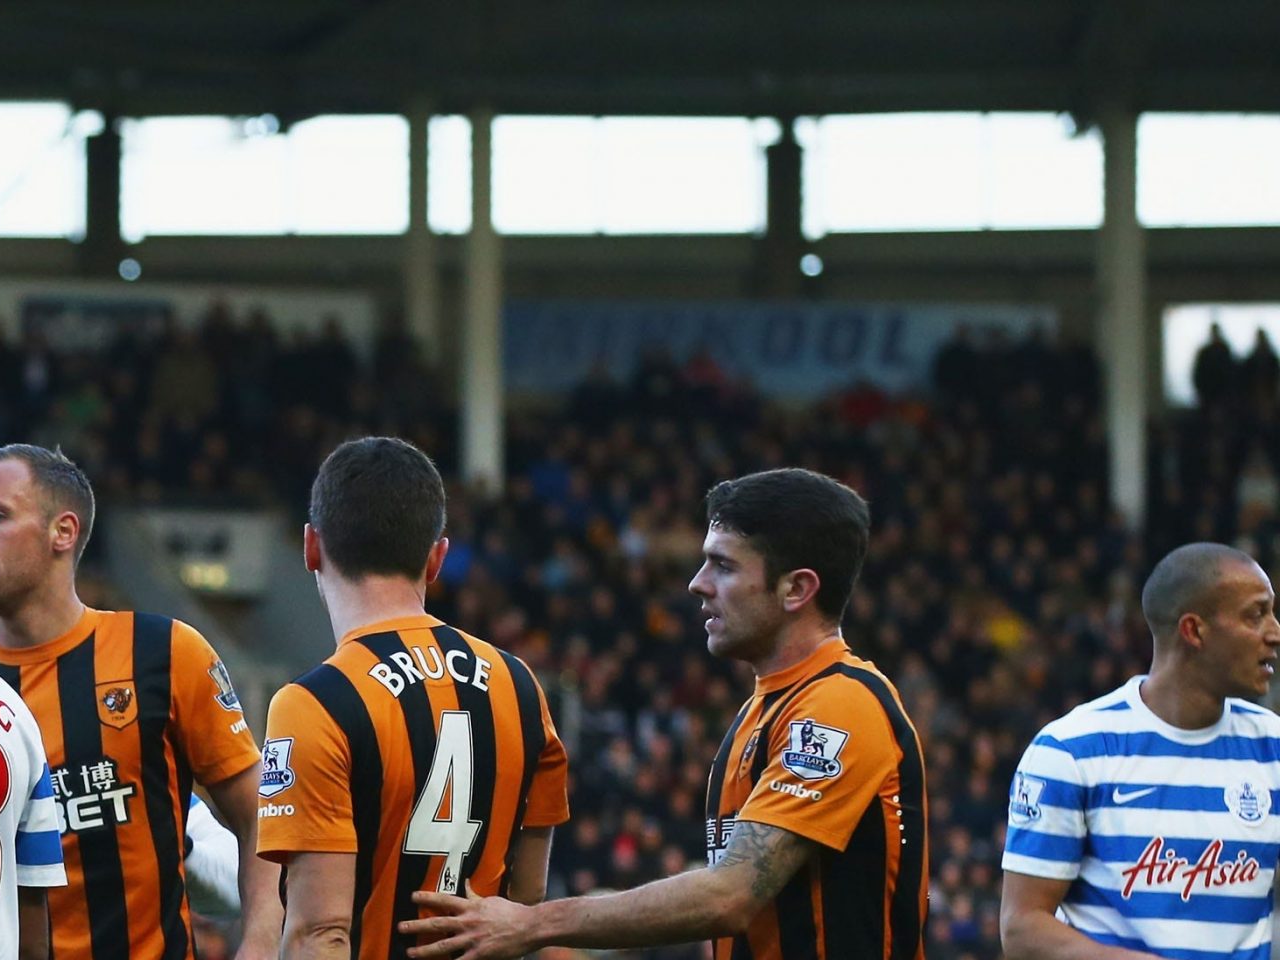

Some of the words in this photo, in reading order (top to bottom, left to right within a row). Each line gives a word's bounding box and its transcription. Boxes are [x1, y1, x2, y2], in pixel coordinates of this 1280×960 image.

[369, 646, 492, 698] BRUCE
[789, 754, 824, 766] BARCLAYS
[770, 780, 822, 801] umbro
[258, 803, 295, 818] mbro
[403, 710, 483, 895] 4
